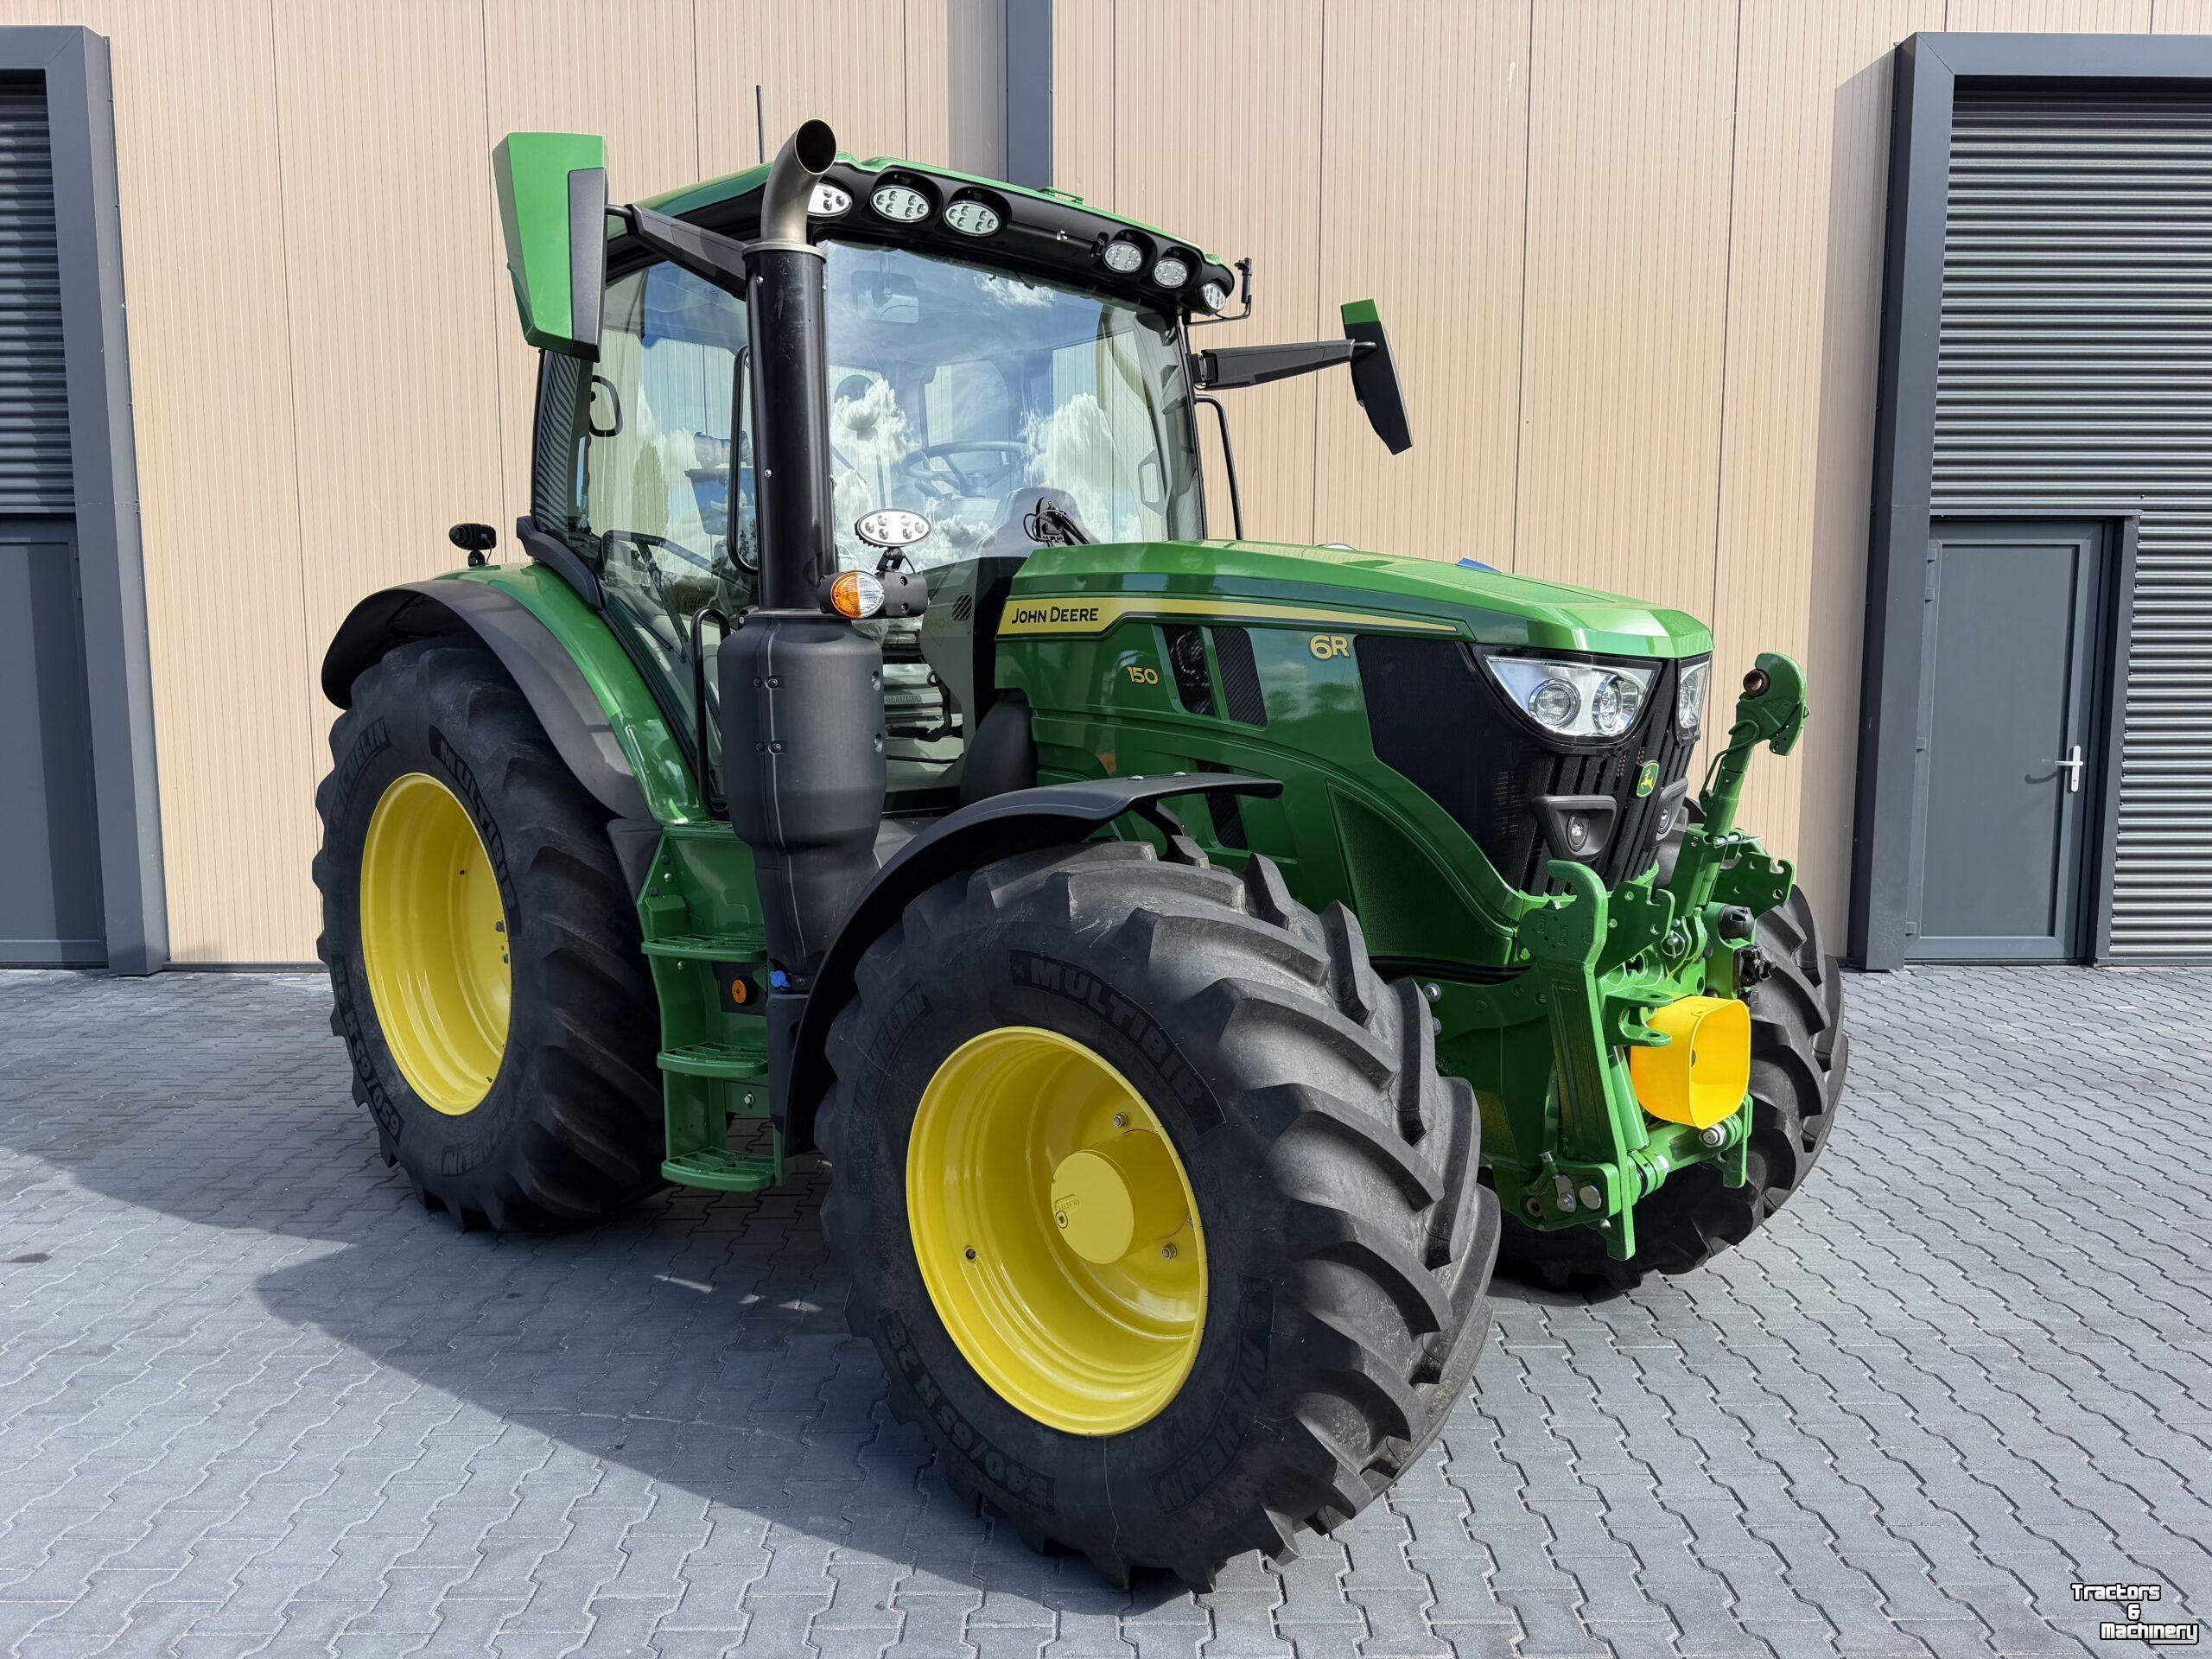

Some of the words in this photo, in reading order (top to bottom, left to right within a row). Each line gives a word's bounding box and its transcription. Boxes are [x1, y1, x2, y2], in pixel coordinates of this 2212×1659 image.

[1012, 607, 1047, 624] JOHN
[1050, 606, 1099, 623] DEERE
[1310, 634, 1350, 660] 6R
[1127, 666, 1160, 685] 150
[440, 738, 516, 909] MULTIBIB
[1030, 957, 1203, 1107] MULTIBIB
[935, 1404, 1047, 1507] 540/65
